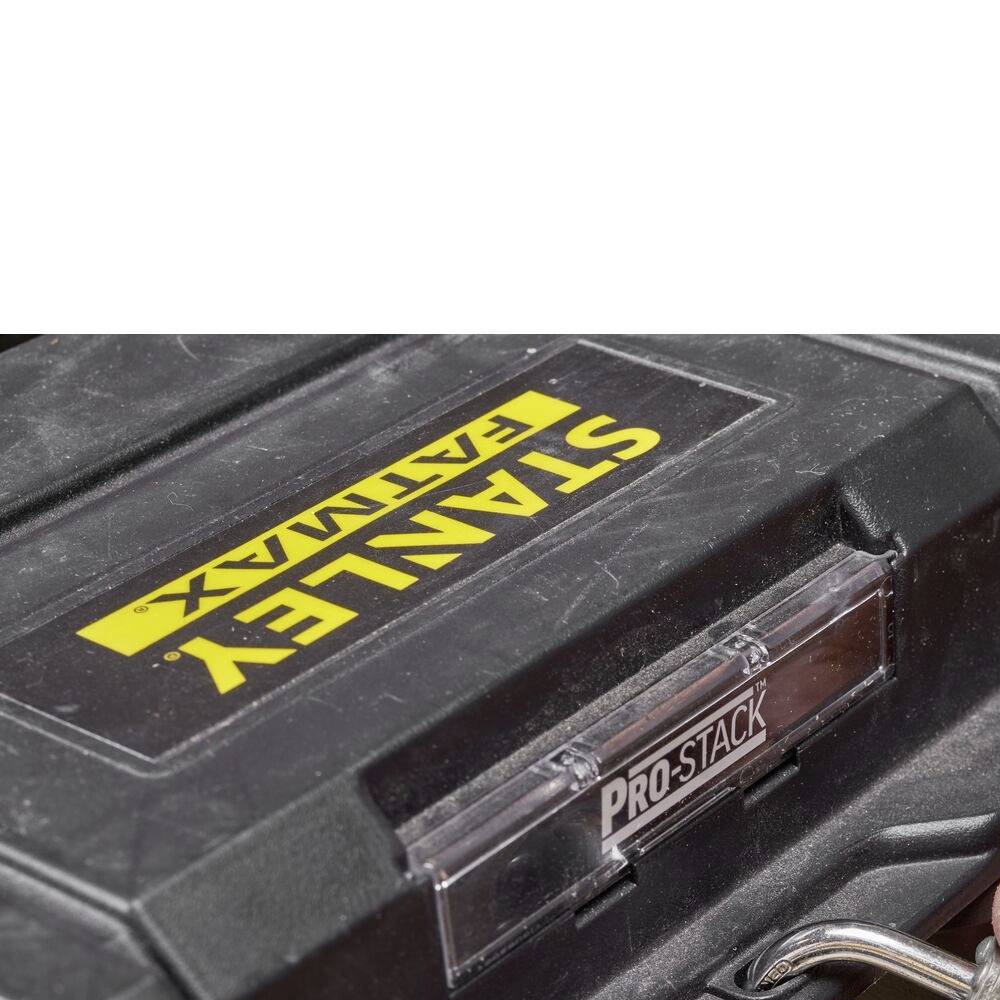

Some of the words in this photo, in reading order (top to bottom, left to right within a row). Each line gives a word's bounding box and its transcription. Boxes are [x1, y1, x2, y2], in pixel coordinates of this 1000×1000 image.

[145, 414, 534, 618] FATMAX
[178, 414, 660, 694] STANLEY
[602, 690, 766, 838] PRO-STACK
